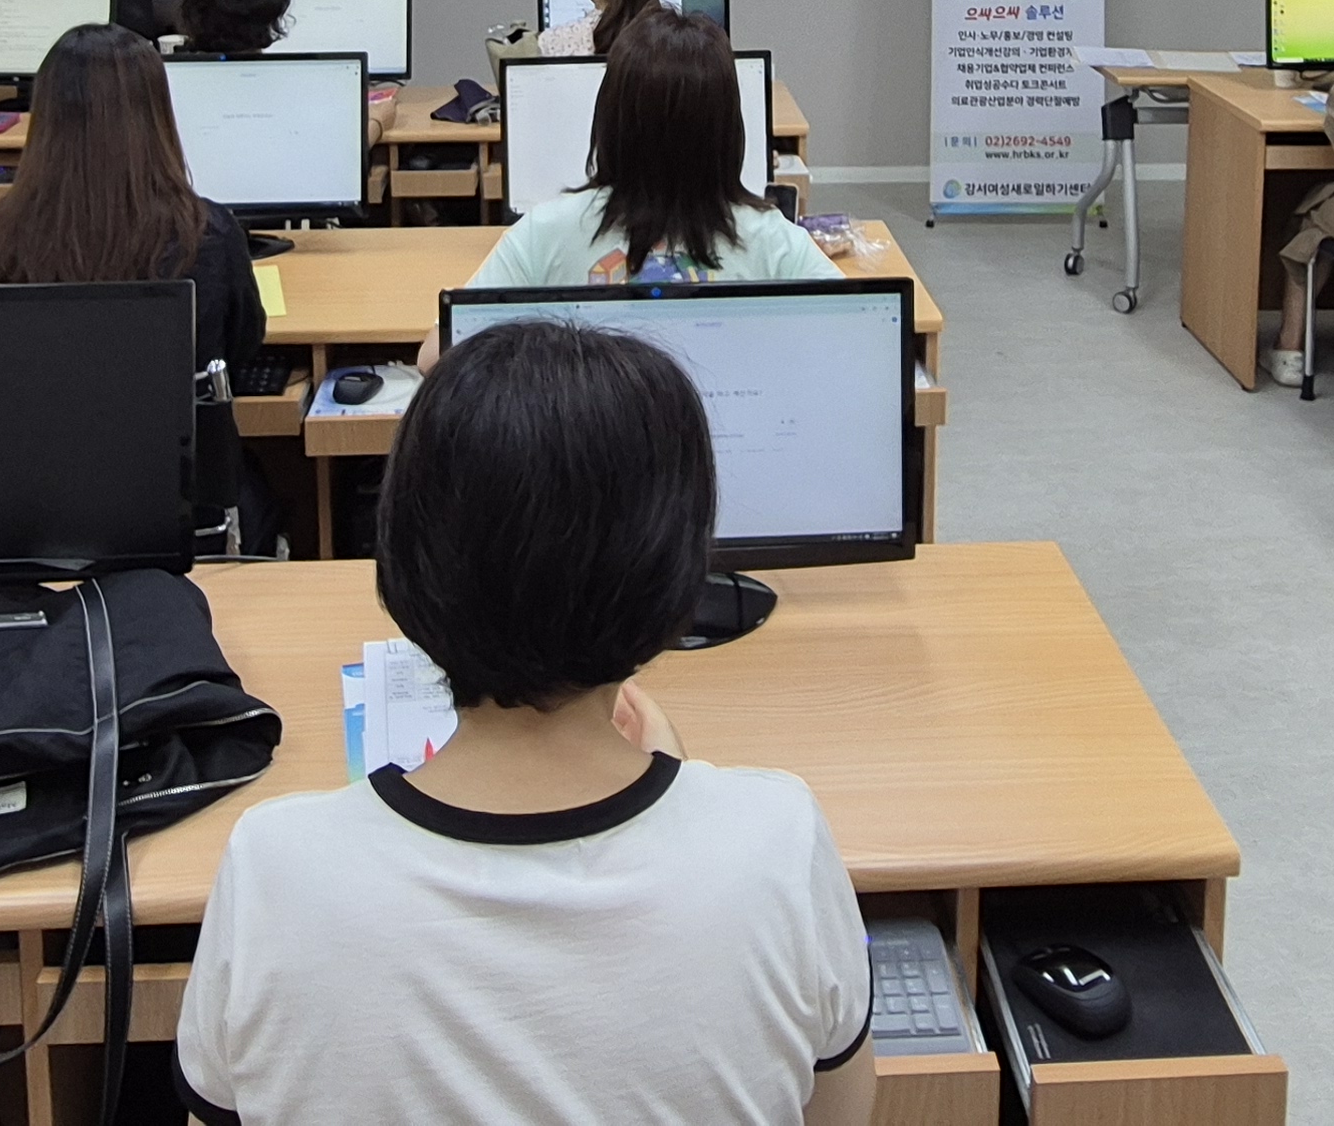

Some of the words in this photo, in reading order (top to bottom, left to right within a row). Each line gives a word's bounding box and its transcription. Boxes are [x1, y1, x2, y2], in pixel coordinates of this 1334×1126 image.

[1025, 5, 1065, 21] 솔루션
[1047, 30, 1073, 42] 컨설팅
[948, 46, 1021, 58] 기업인식개선강의
[1039, 62, 1075, 74] 컨퍼런스
[964, 79, 1019, 91] 취업성공수다
[1021, 79, 1067, 91] 토크콘서트
[951, 95, 1024, 107] 의료관광산업분야
[1026, 96, 1080, 108] 경력단절예방
[985, 150, 1070, 160] www.hrbks.or.kr
[964, 182, 1093, 196] 강서여성새로일하기센터
